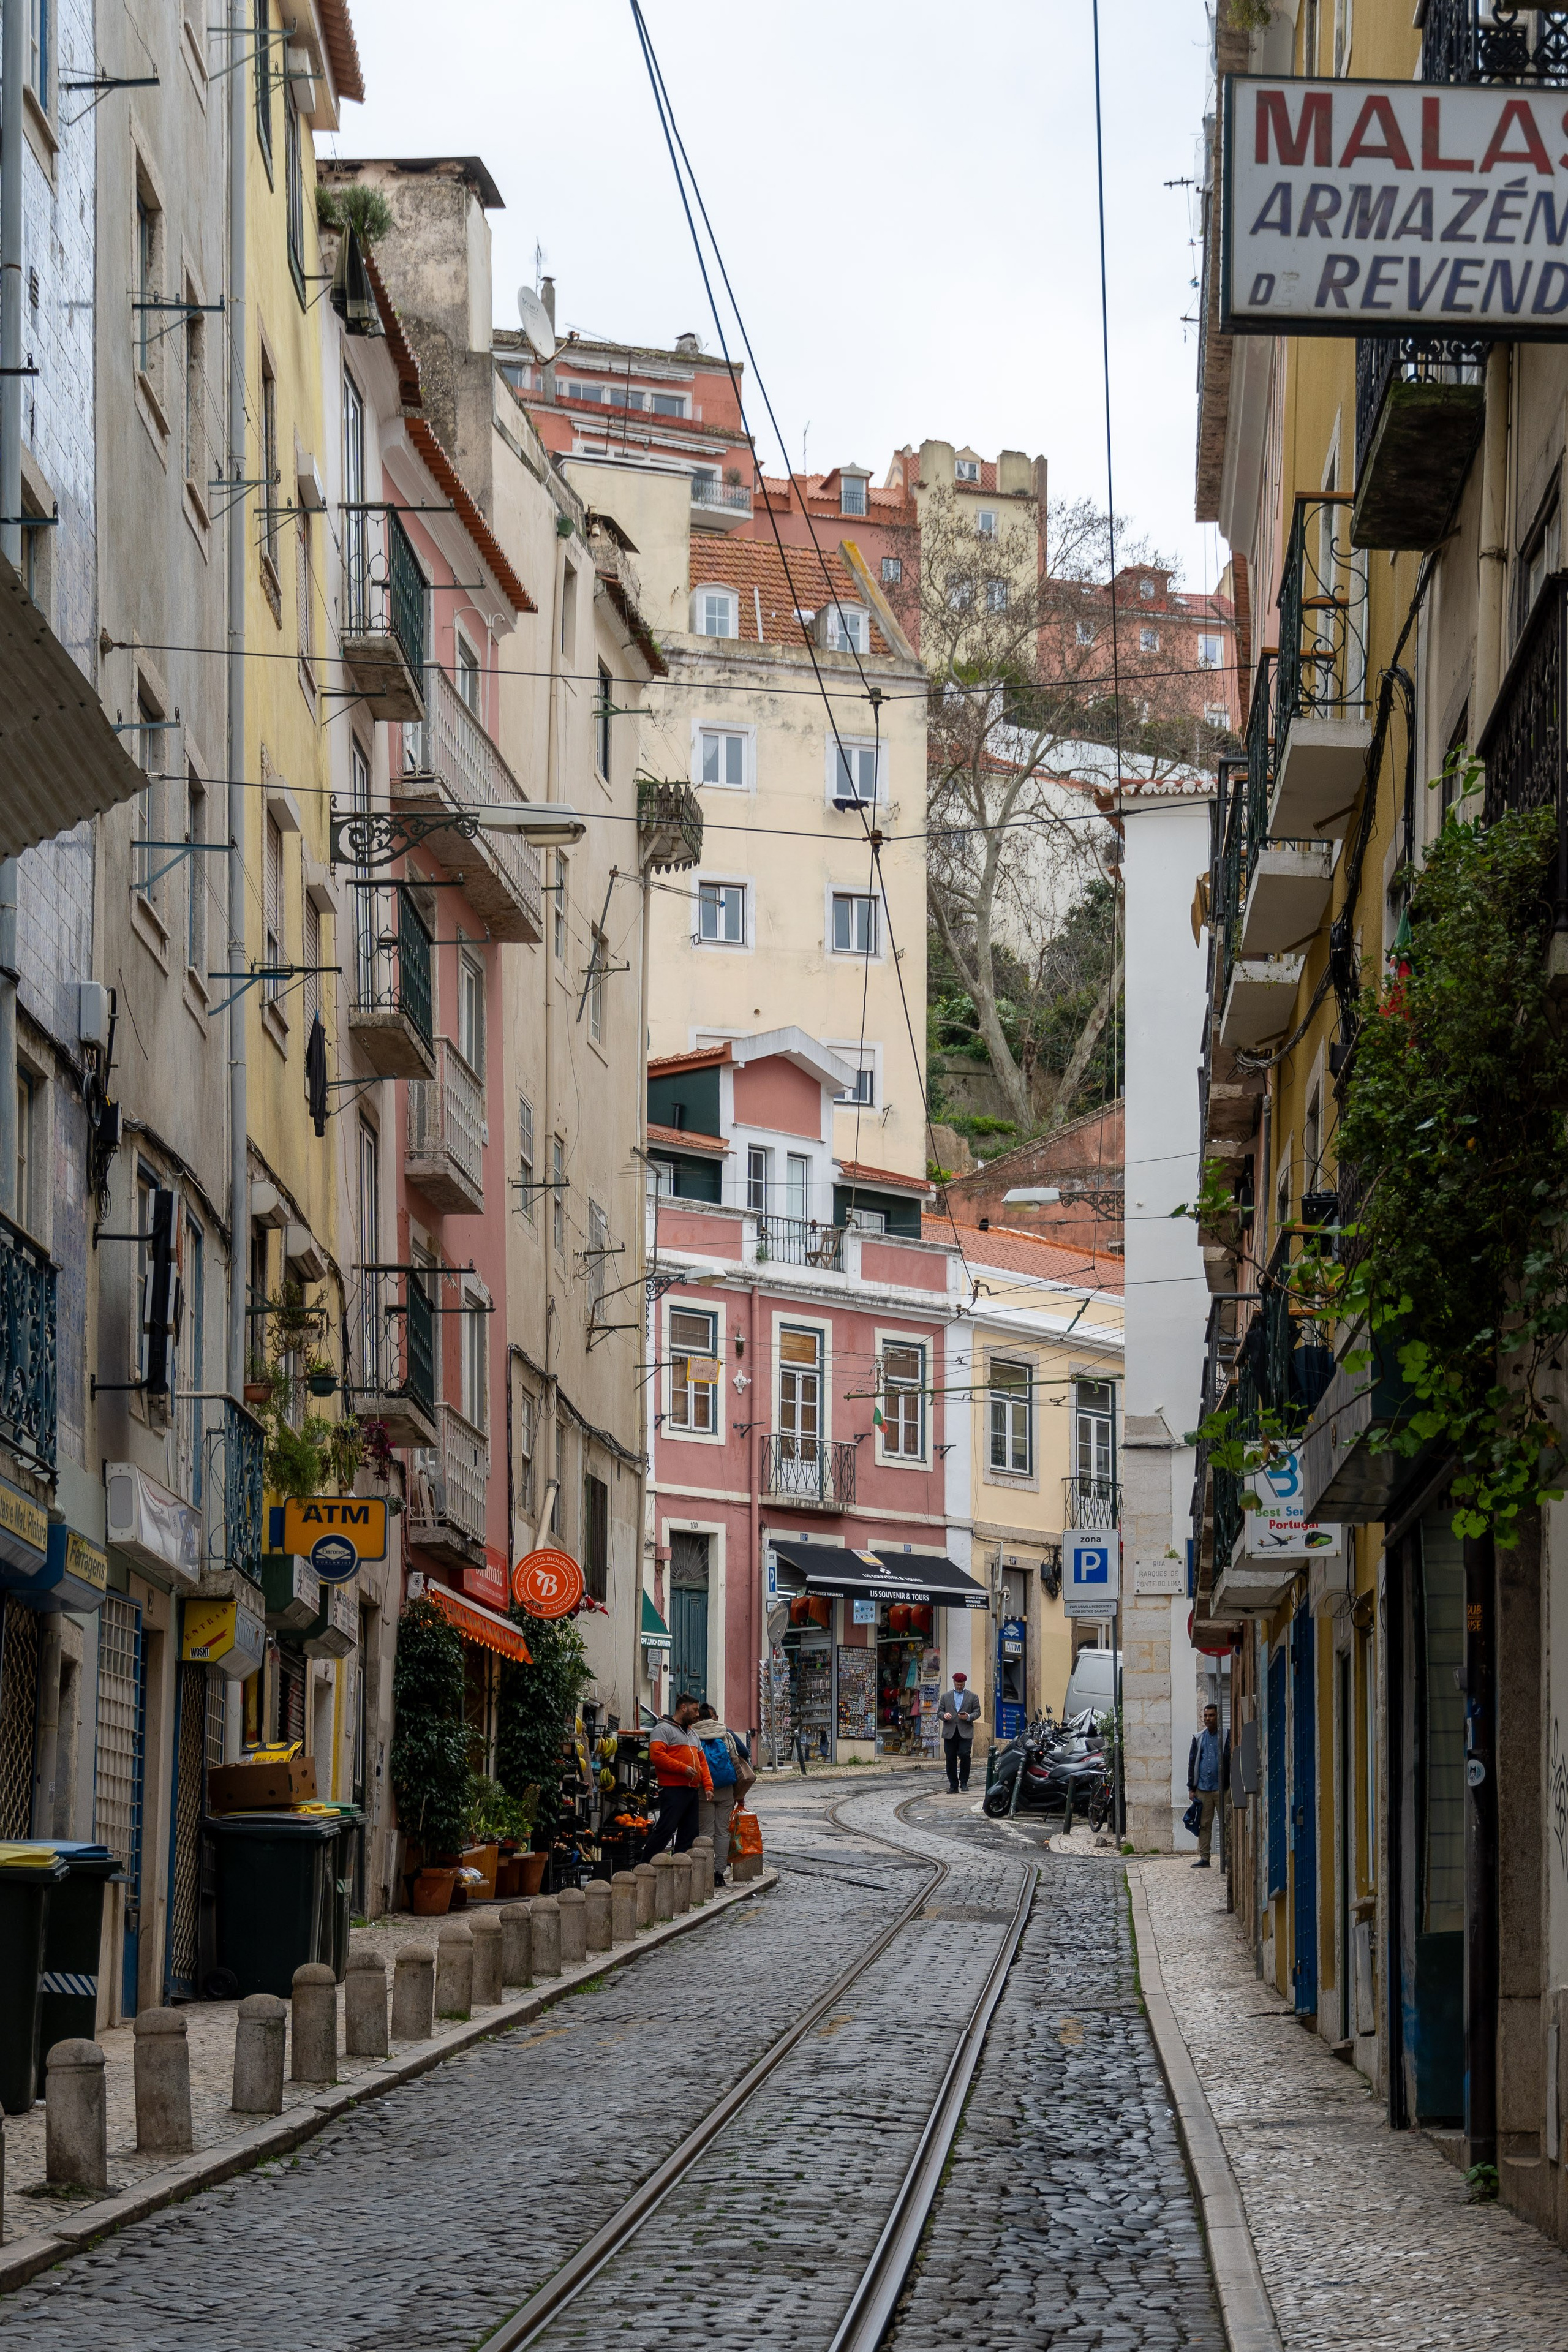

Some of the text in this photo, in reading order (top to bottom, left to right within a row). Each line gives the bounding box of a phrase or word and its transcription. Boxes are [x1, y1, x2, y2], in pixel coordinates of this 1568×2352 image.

[1255, 90, 1568, 175] MALA
[302, 1504, 369, 1525] ATM
[1256, 1507, 1281, 1517] Best
[10, 1507, 13, 1524] e
[28, 1510, 47, 1546] Pintura
[69, 1539, 105, 1582] Ferragens
[520, 1556, 545, 1581] PRODUTOS
[1081, 1551, 1101, 1580] P
[770, 1569, 775, 1591] P
[553, 1586, 575, 1611] NATURAIS
[878, 1591, 905, 1599] SOUVENIR
[190, 1648, 209, 1657] WOSNT
[1006, 1643, 1020, 1652] ATM
